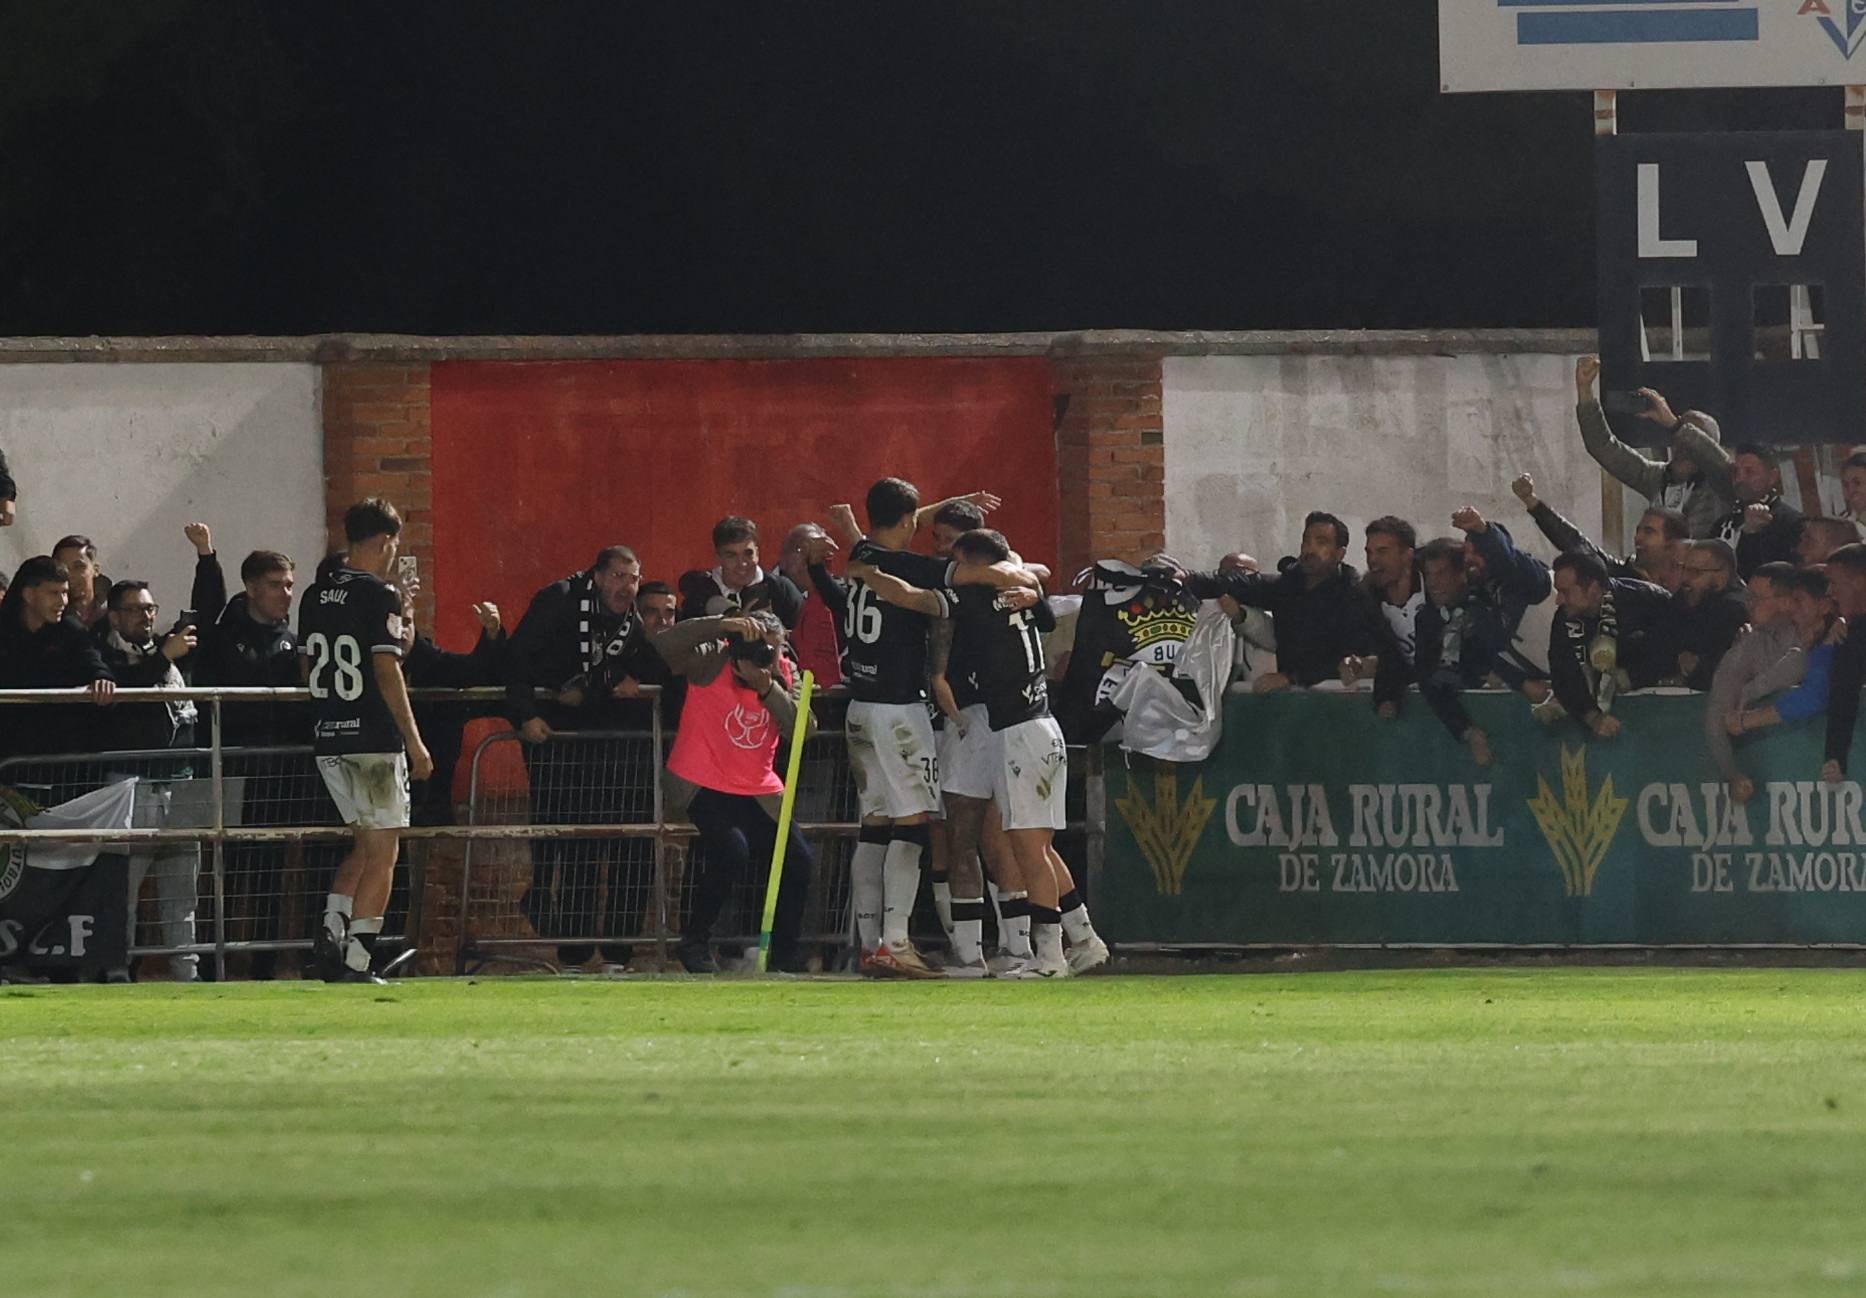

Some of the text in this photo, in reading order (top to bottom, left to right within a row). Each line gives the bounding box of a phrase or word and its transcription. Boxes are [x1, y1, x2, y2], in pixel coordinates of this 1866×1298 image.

[1637, 159, 1828, 258] L V
[844, 577, 882, 644] 36
[306, 632, 364, 701] 28
[1225, 783, 1504, 852] CAJA RURAL
[1636, 782, 1754, 852] CAJA
[1278, 853, 1460, 893] DE ZAMORA
[1691, 853, 1734, 893] DE
